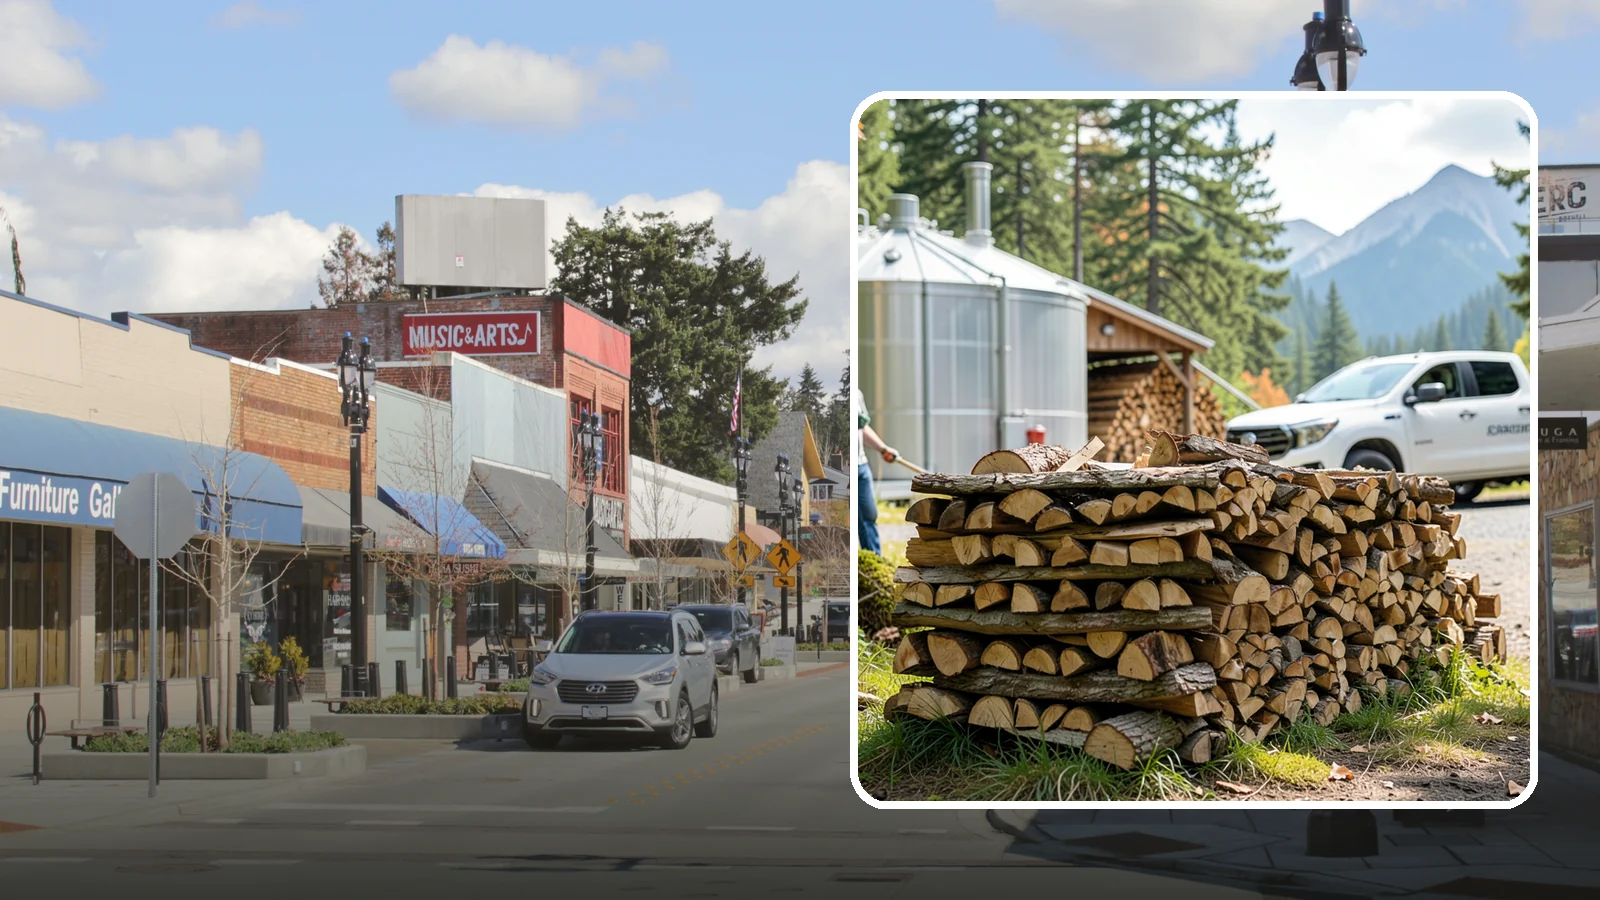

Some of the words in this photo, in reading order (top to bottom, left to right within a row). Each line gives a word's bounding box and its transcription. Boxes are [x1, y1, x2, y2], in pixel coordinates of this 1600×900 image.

[0, 471, 79, 515] Furniture
[89, 482, 122, 519] Gal
[453, 562, 479, 574] SUSHI
